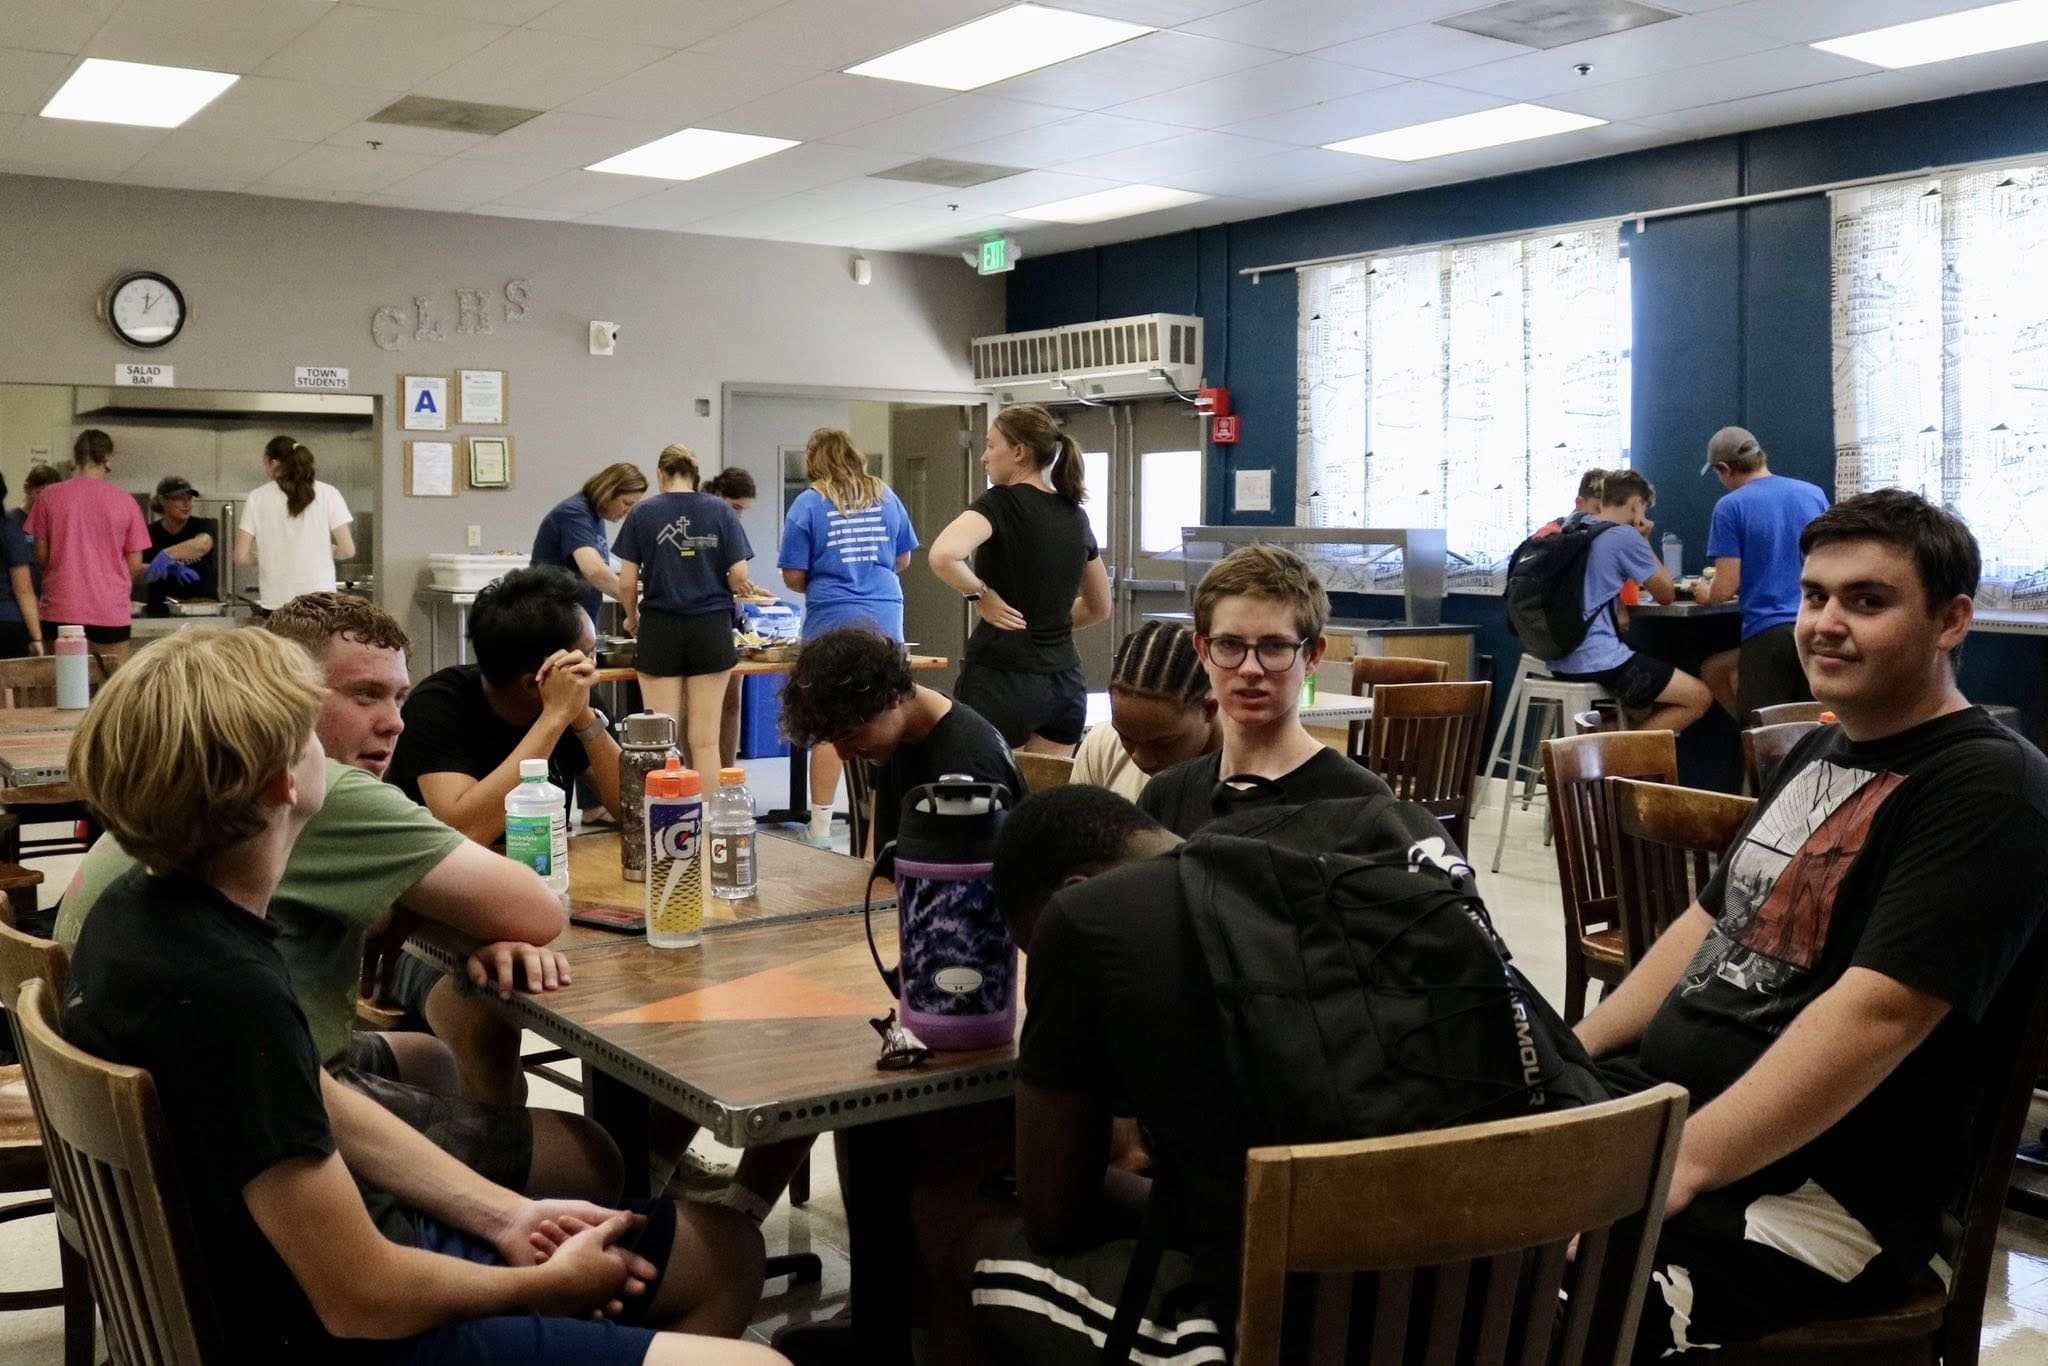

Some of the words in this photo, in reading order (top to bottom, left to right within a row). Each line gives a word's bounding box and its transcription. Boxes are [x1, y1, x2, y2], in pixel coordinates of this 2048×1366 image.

[984, 241, 1005, 270] EXIT
[127, 365, 161, 376] SALAD
[306, 368, 338, 378] TOWN
[132, 375, 153, 385] BAR
[297, 377, 347, 387] STUDENTS
[414, 389, 437, 413] A
[711, 838, 728, 864] G
